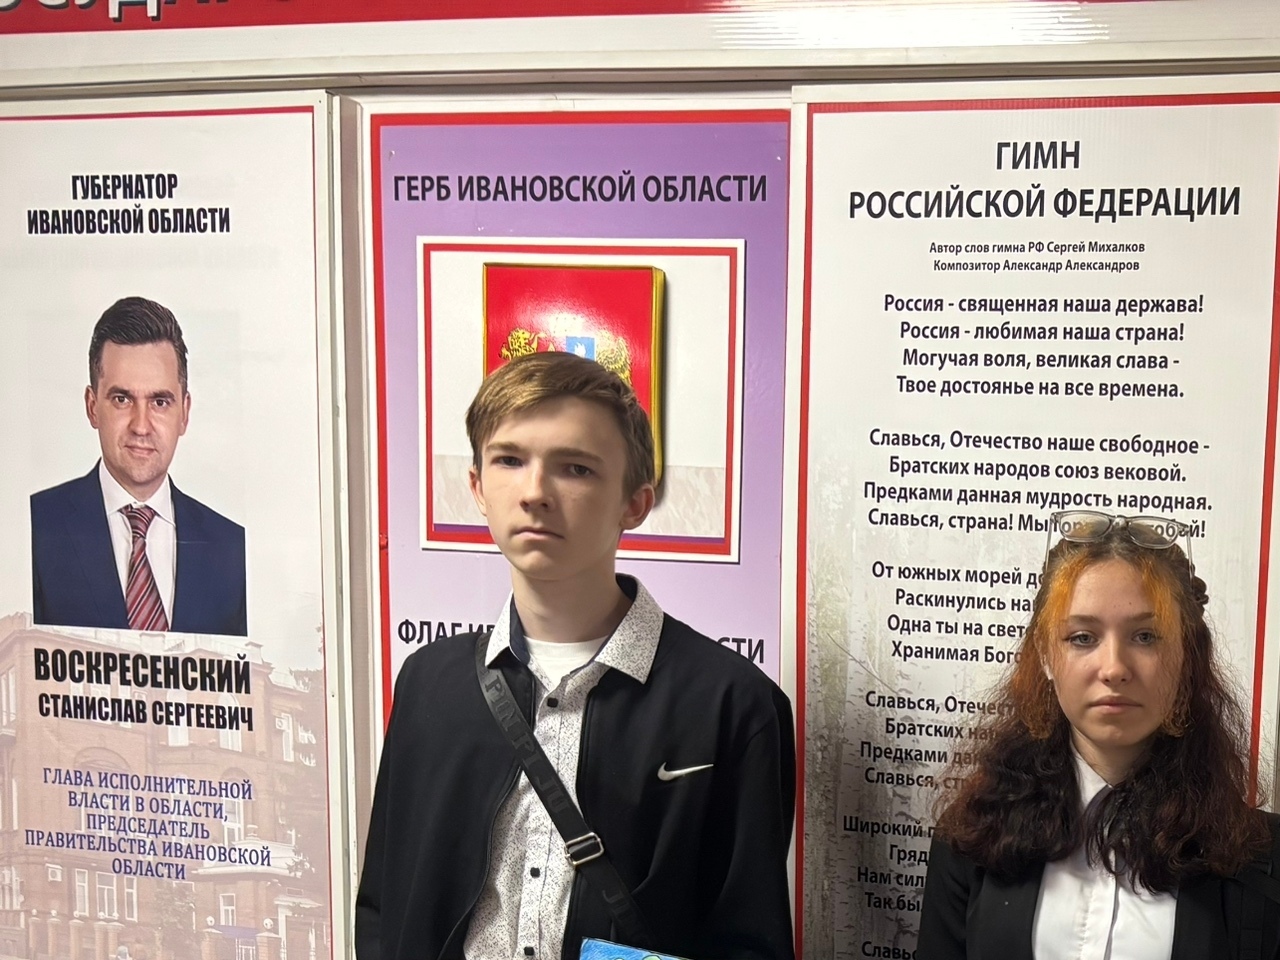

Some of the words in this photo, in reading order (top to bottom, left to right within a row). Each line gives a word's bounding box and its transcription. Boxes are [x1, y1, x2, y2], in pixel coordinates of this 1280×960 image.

[996, 141, 1080, 170] ГИМН
[72, 174, 178, 199] ГУБЕРНАТОР
[393, 176, 451, 202] ГЕРБ
[457, 170, 638, 203] ИВАНОВСКОЙ
[642, 175, 768, 202] ОБЛАСТИ
[849, 184, 1046, 219] РОССИЙСКОЙ
[1053, 187, 1240, 223] ФЕДЕРАЦИИ
[27, 205, 144, 234] ИВАНОВСКОЙ
[148, 208, 230, 233] ОБЛАСТИ
[929, 242, 962, 256] Автор
[965, 244, 989, 254] слов
[992, 244, 1026, 254] гимна
[1028, 241, 1044, 254] РФ
[1047, 241, 1086, 256] Сергей
[1088, 241, 1145, 253] Михалков
[933, 260, 1000, 274] Композитор
[1003, 259, 1062, 273] Александр
[1065, 259, 1139, 273] Александров
[884, 295, 943, 312] Россия
[958, 298, 1058, 315] священная
[1063, 299, 1111, 313] наша
[1115, 295, 1204, 317] держава!
[900, 321, 960, 340] Россия
[974, 321, 1058, 341] любимая
[1063, 327, 1110, 341] наша
[1115, 322, 1184, 346] страна!
[903, 349, 979, 372] Могучая
[983, 353, 1030, 371] воля,
[1035, 354, 1111, 369] великая
[1116, 355, 1167, 370] слава
[896, 375, 936, 394] Твое
[940, 380, 1035, 398] достоянье
[1039, 381, 1059, 396] на
[1064, 382, 1094, 397] все
[1099, 383, 1185, 402] времена.
[869, 428, 946, 450] Славься,
[950, 430, 1043, 451] Отечество
[1047, 436, 1094, 451] наше
[1099, 435, 1199, 457] свободное
[889, 455, 969, 478] Братских
[974, 462, 1050, 480] народов
[1055, 464, 1099, 480] союз
[1104, 461, 1187, 483] вековой.
[863, 481, 953, 505] Предками
[957, 488, 1022, 507] данная
[1026, 491, 1112, 512] мудрость
[1117, 493, 1213, 513] народная.
[868, 508, 944, 531] Славься,
[948, 513, 1014, 536] страна!
[1018, 515, 1049, 533] Мы
[872, 561, 893, 578] От
[898, 566, 961, 582] южных
[965, 567, 1022, 588] морей
[896, 588, 1006, 613] Раскинулись
[887, 614, 931, 635] Одна
[936, 621, 958, 634] ты
[963, 623, 983, 636] на
[892, 640, 979, 663] Хранимая
[34, 648, 251, 694] ВОСКРЕСЕНСКИЙ
[38, 693, 146, 723] СТАНИСЛАВ
[152, 701, 253, 731] СЕРГЕЕВИЧ
[865, 690, 941, 713] Славься,
[885, 718, 964, 740] Братских
[860, 741, 948, 765] Предками
[43, 768, 94, 788] ГЛАВА
[98, 772, 252, 799] ИСПОЛНИТЕЛЬНОЙ
[68, 791, 130, 811] ВЛАСТИ
[135, 796, 145, 812] В
[149, 797, 228, 822] ОБЛАСТИ,
[86, 814, 210, 840] ПРЕДСЕДАТЕЛЬ
[843, 815, 922, 837] Широкий
[25, 830, 157, 856] ПРАВИТЕЛЬСТВА
[162, 842, 271, 866] ИВАНОВСКОЙ
[112, 858, 186, 880] ОБЛАСТИ
[857, 866, 891, 885] Нам
[864, 891, 892, 909] Так
